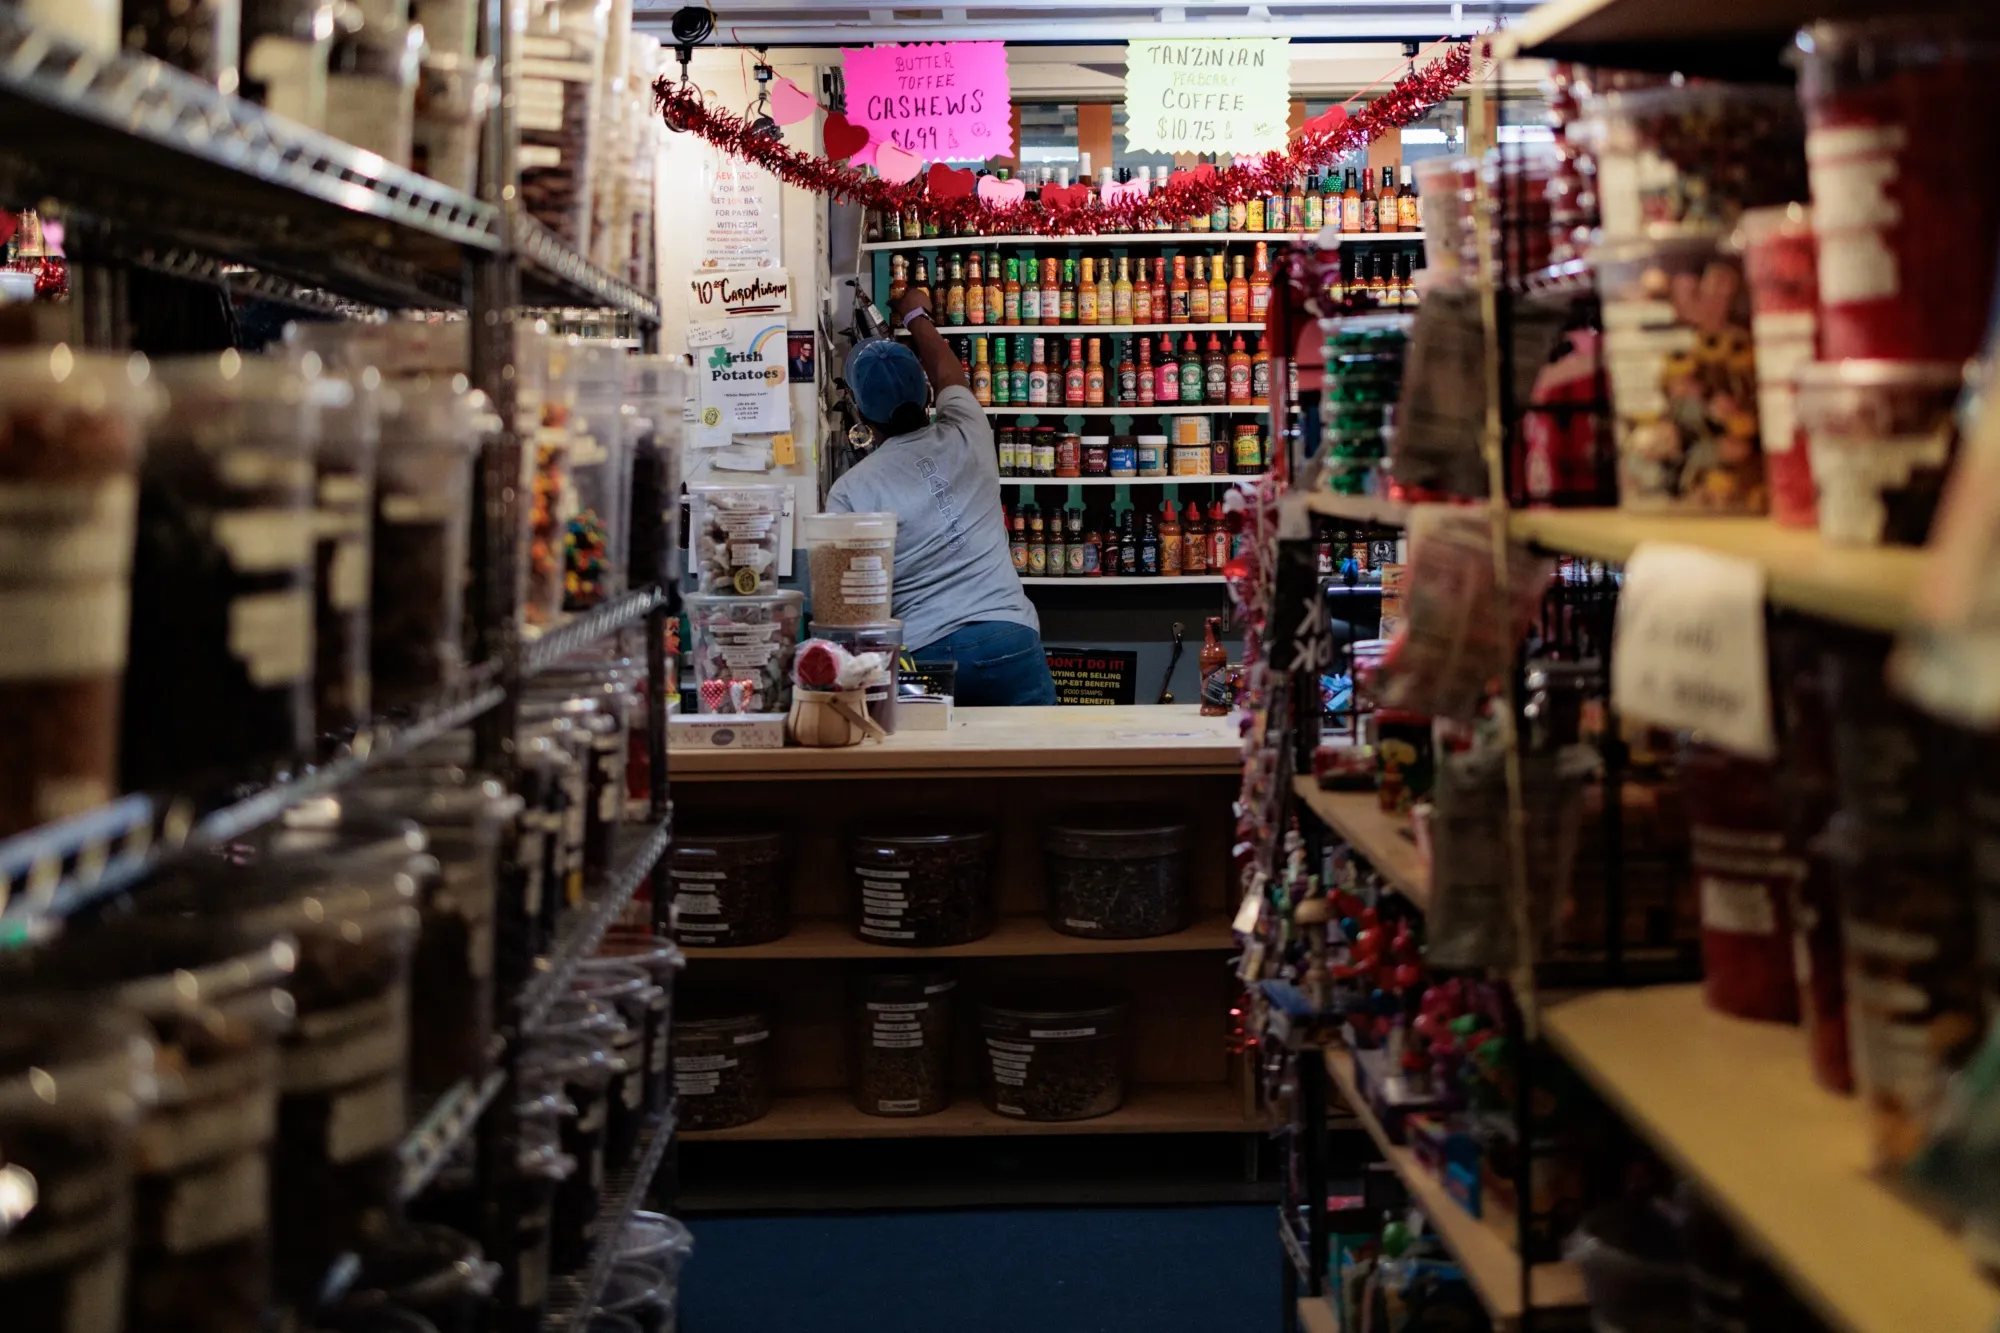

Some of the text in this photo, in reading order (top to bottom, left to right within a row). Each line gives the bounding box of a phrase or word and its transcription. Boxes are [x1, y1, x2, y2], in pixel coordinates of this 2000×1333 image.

[895, 52, 954, 72] BUTTER
[898, 73, 955, 90] TOFFEE
[867, 89, 984, 121] CASHEWS
[1162, 88, 1244, 111] COFFEE
[1157, 116, 1215, 142] $10.75
[726, 351, 763, 363] Irish
[712, 370, 778, 381] Potatoes
[1046, 657, 1125, 670] DON'T DO IT!
